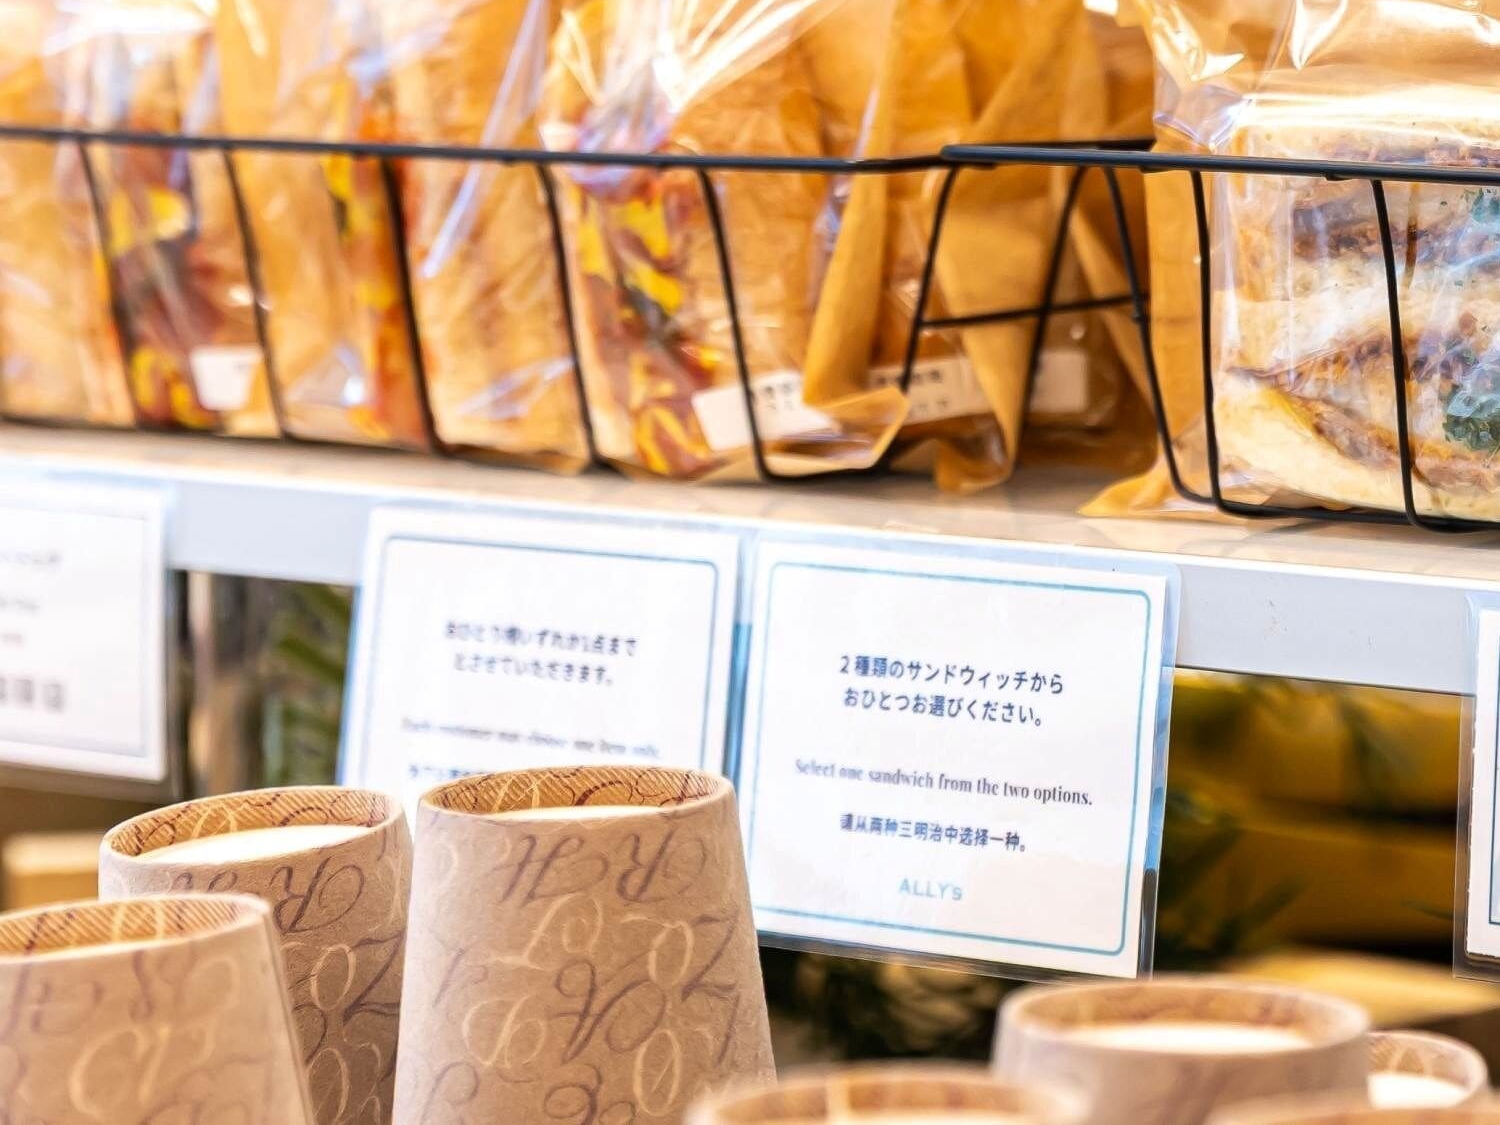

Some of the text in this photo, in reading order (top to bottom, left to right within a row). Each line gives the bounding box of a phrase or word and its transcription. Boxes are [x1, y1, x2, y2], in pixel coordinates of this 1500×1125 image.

[843, 687, 1042, 726] おひとつお選びください。
[795, 758, 836, 778] Select
[868, 768, 934, 789] sandwich
[937, 773, 972, 793] from
[976, 777, 999, 796] the
[1003, 781, 1030, 799] two
[1033, 785, 1093, 806] options.
